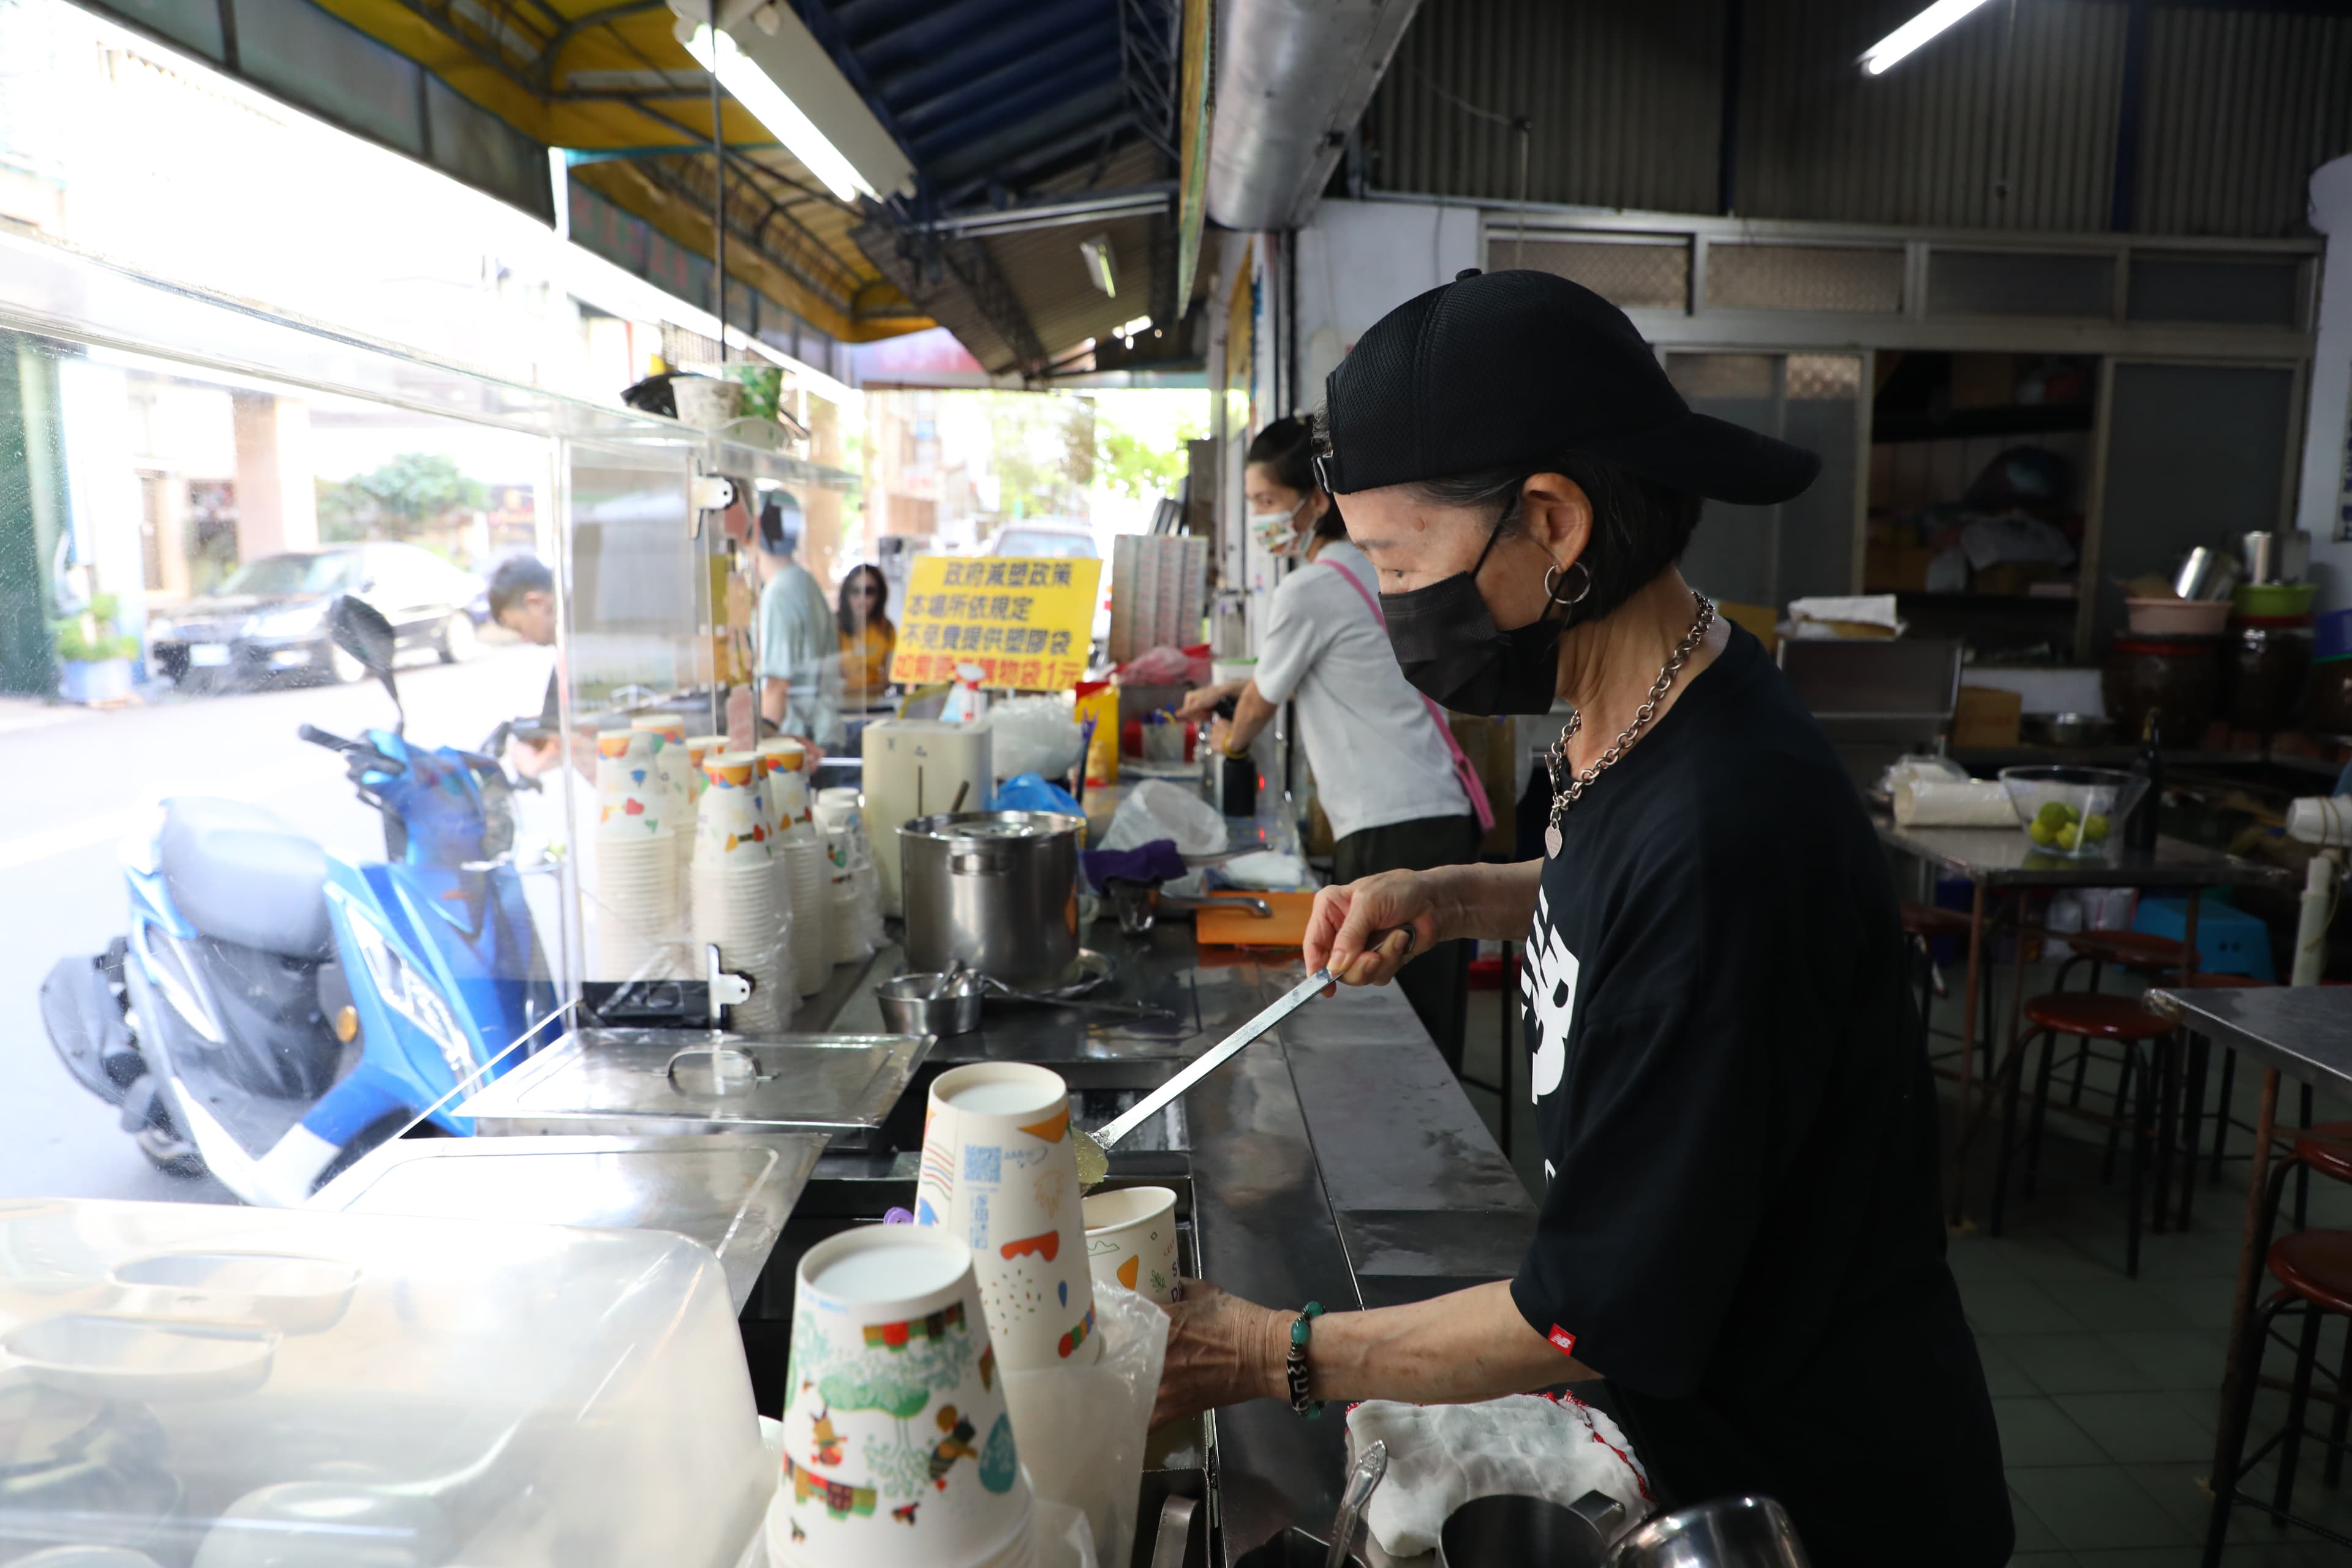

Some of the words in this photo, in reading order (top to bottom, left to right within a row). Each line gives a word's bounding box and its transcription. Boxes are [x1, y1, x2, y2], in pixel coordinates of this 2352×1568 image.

[908, 594, 1033, 620] 本場所依規定
[903, 624, 1071, 655] 不免費提供塑膠袋
